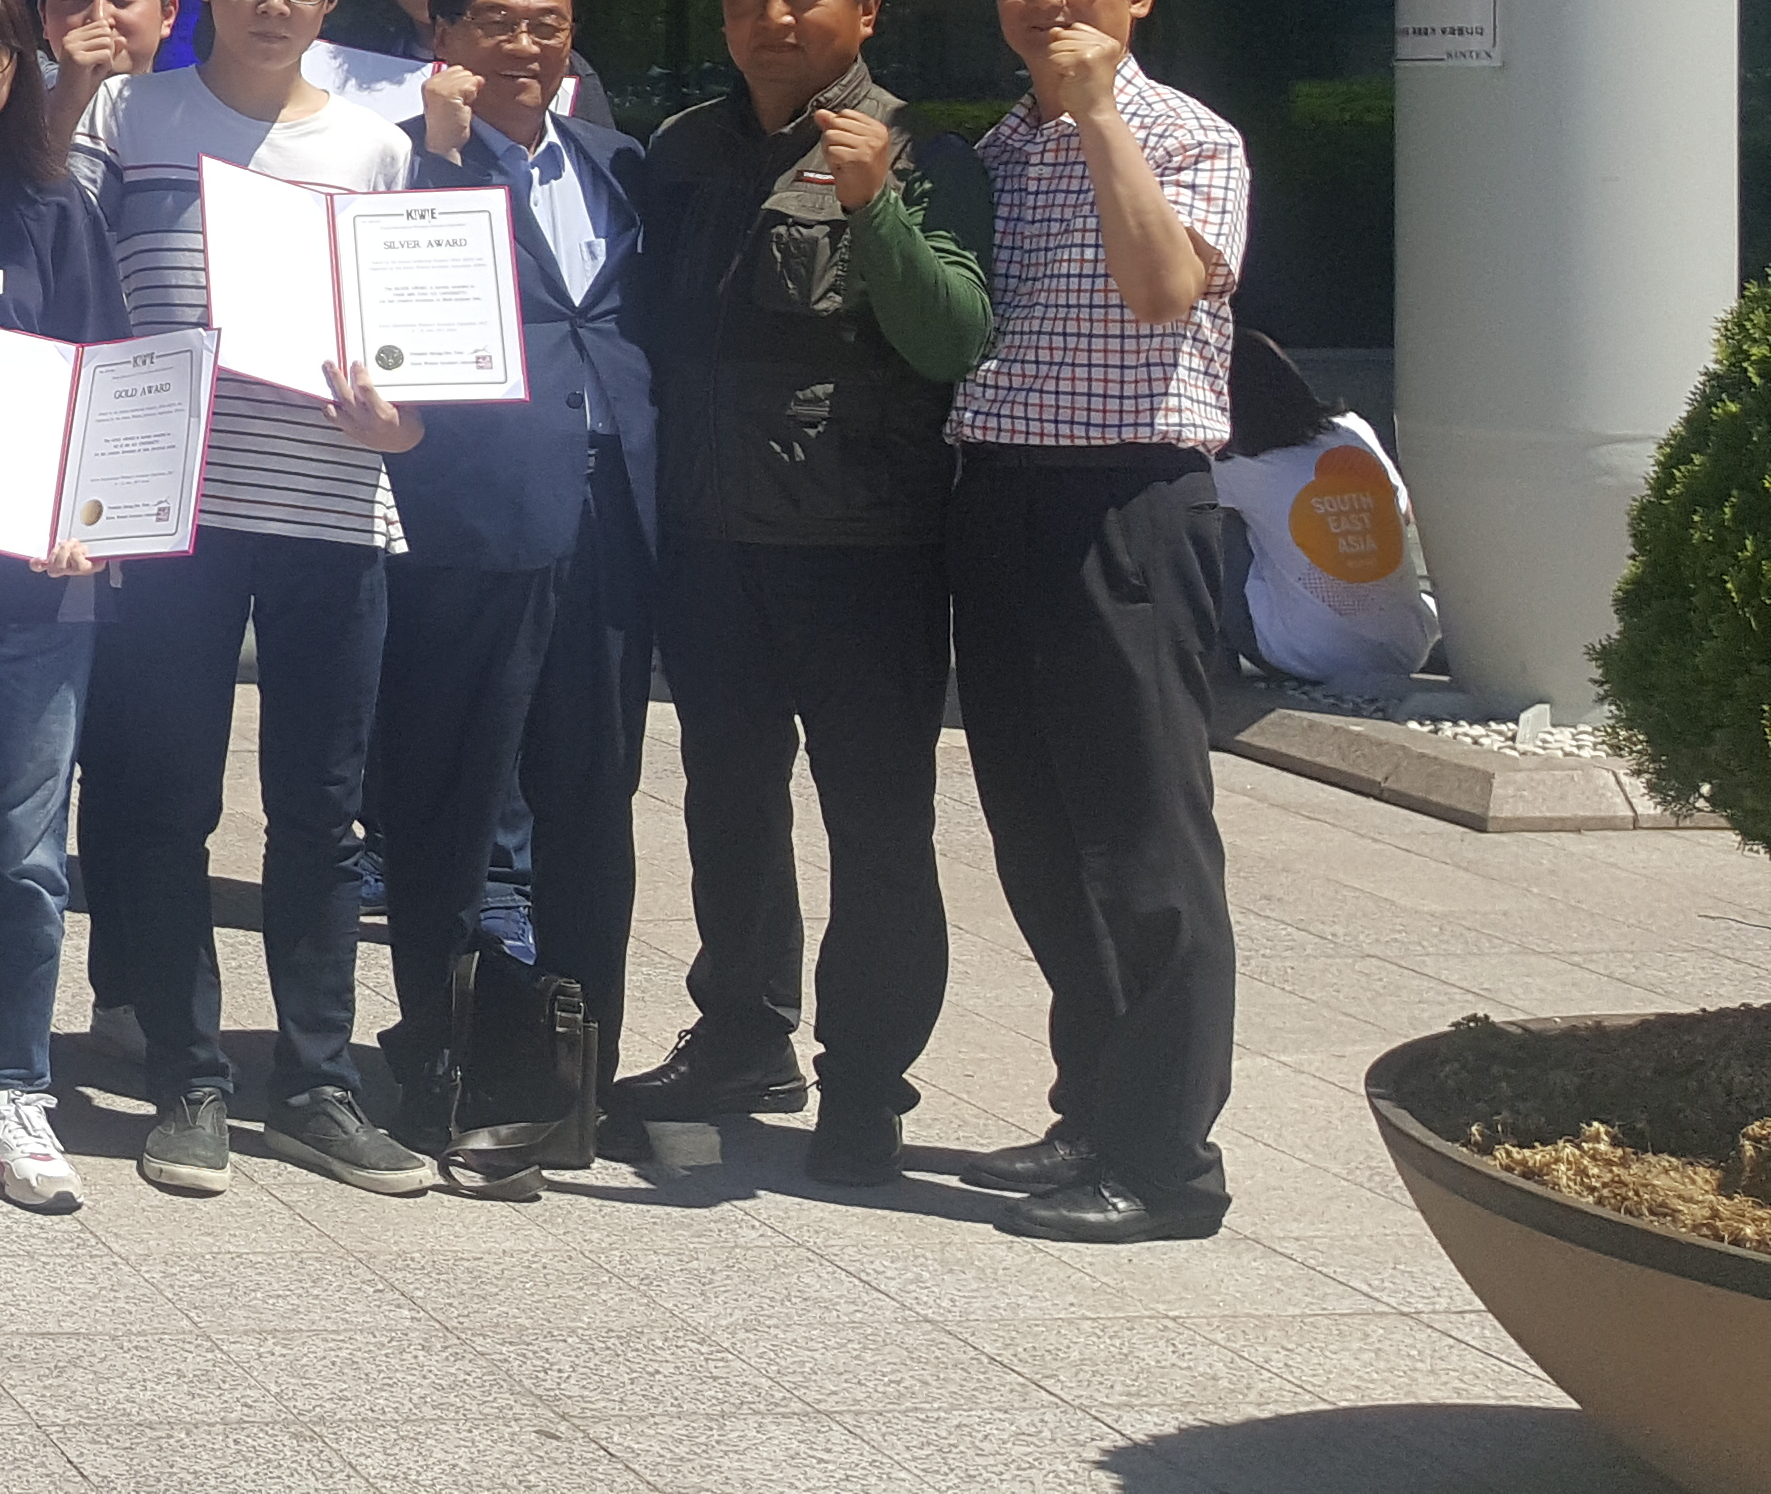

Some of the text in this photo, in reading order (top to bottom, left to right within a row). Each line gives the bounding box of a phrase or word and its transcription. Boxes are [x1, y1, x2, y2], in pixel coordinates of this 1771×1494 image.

[383, 238, 467, 250] SILVER AWARD
[114, 382, 171, 400] GOLD AWARD
[1311, 492, 1374, 513] SOUTH
[1327, 514, 1372, 533] EAST
[1337, 535, 1378, 554] ASIA
